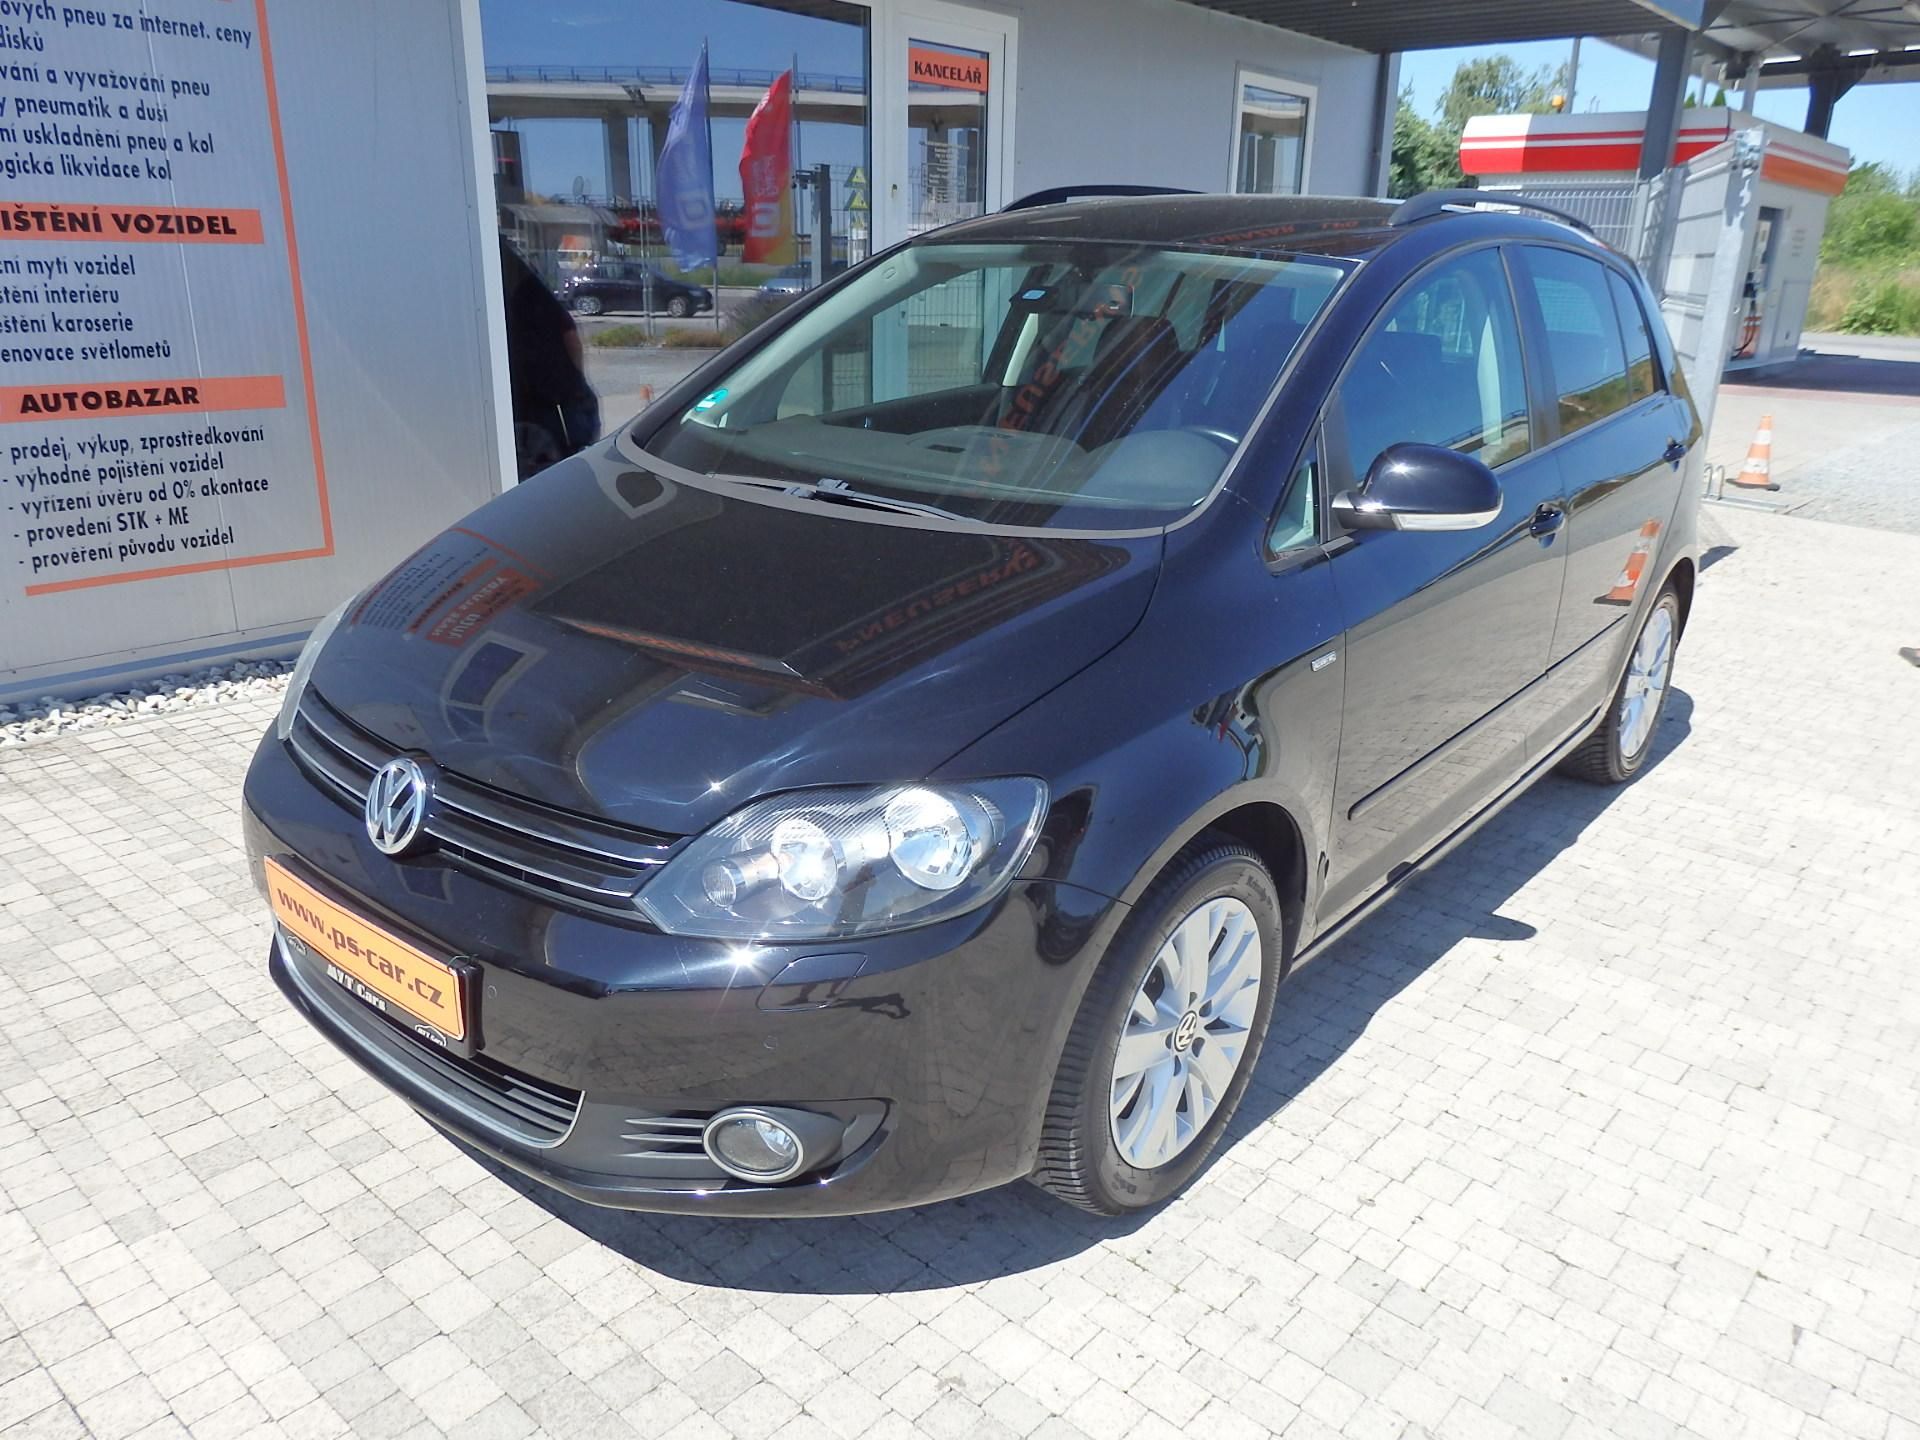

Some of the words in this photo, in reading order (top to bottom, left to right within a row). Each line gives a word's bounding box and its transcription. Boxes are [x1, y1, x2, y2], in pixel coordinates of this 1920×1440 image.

[62, 7, 107, 28] pneu
[111, 12, 134, 31] za
[138, 8, 211, 40] internet.
[215, 25, 252, 49] ceny
[46, 68, 58, 84] a
[63, 69, 166, 93] vyvažování
[171, 78, 211, 98] pneu
[914, 61, 982, 84] KANCELÁŘ
[14, 95, 112, 119] pneumatik
[118, 104, 130, 119] a
[0, 122, 17, 143] ní
[22, 121, 122, 150] uskladnění
[127, 135, 168, 154] pneu
[173, 135, 183, 151] a
[188, 131, 215, 154] kol
[60, 153, 141, 179] likvidace
[146, 157, 173, 181] kol
[111, 213, 237, 235] VOZIDEL
[73, 253, 137, 277] vozidel
[43, 282, 120, 304] interiéru
[0, 314, 47, 333] štění
[51, 311, 135, 333] karoserie
[81, 338, 172, 360] světlometů
[19, 385, 201, 415] AUTOBAZAR
[10, 435, 72, 466] prodej,
[77, 433, 134, 460] výkup,
[140, 425, 264, 454] zprostředkování
[15, 465, 92, 493] výhodné
[97, 457, 165, 485] pojištění
[169, 450, 225, 474] vozidel
[20, 490, 93, 520] vyřízení
[97, 488, 144, 509] úvěru
[149, 481, 167, 502] od
[172, 478, 197, 500] 0%
[200, 477, 270, 497] akontace
[26, 516, 113, 547] provedení
[116, 510, 149, 533] STK
[168, 506, 190, 526] ME
[32, 541, 113, 574] prověření
[118, 533, 176, 562] původu
[180, 526, 235, 549] vozidel
[277, 888, 445, 1009] www.ps-car.cz
